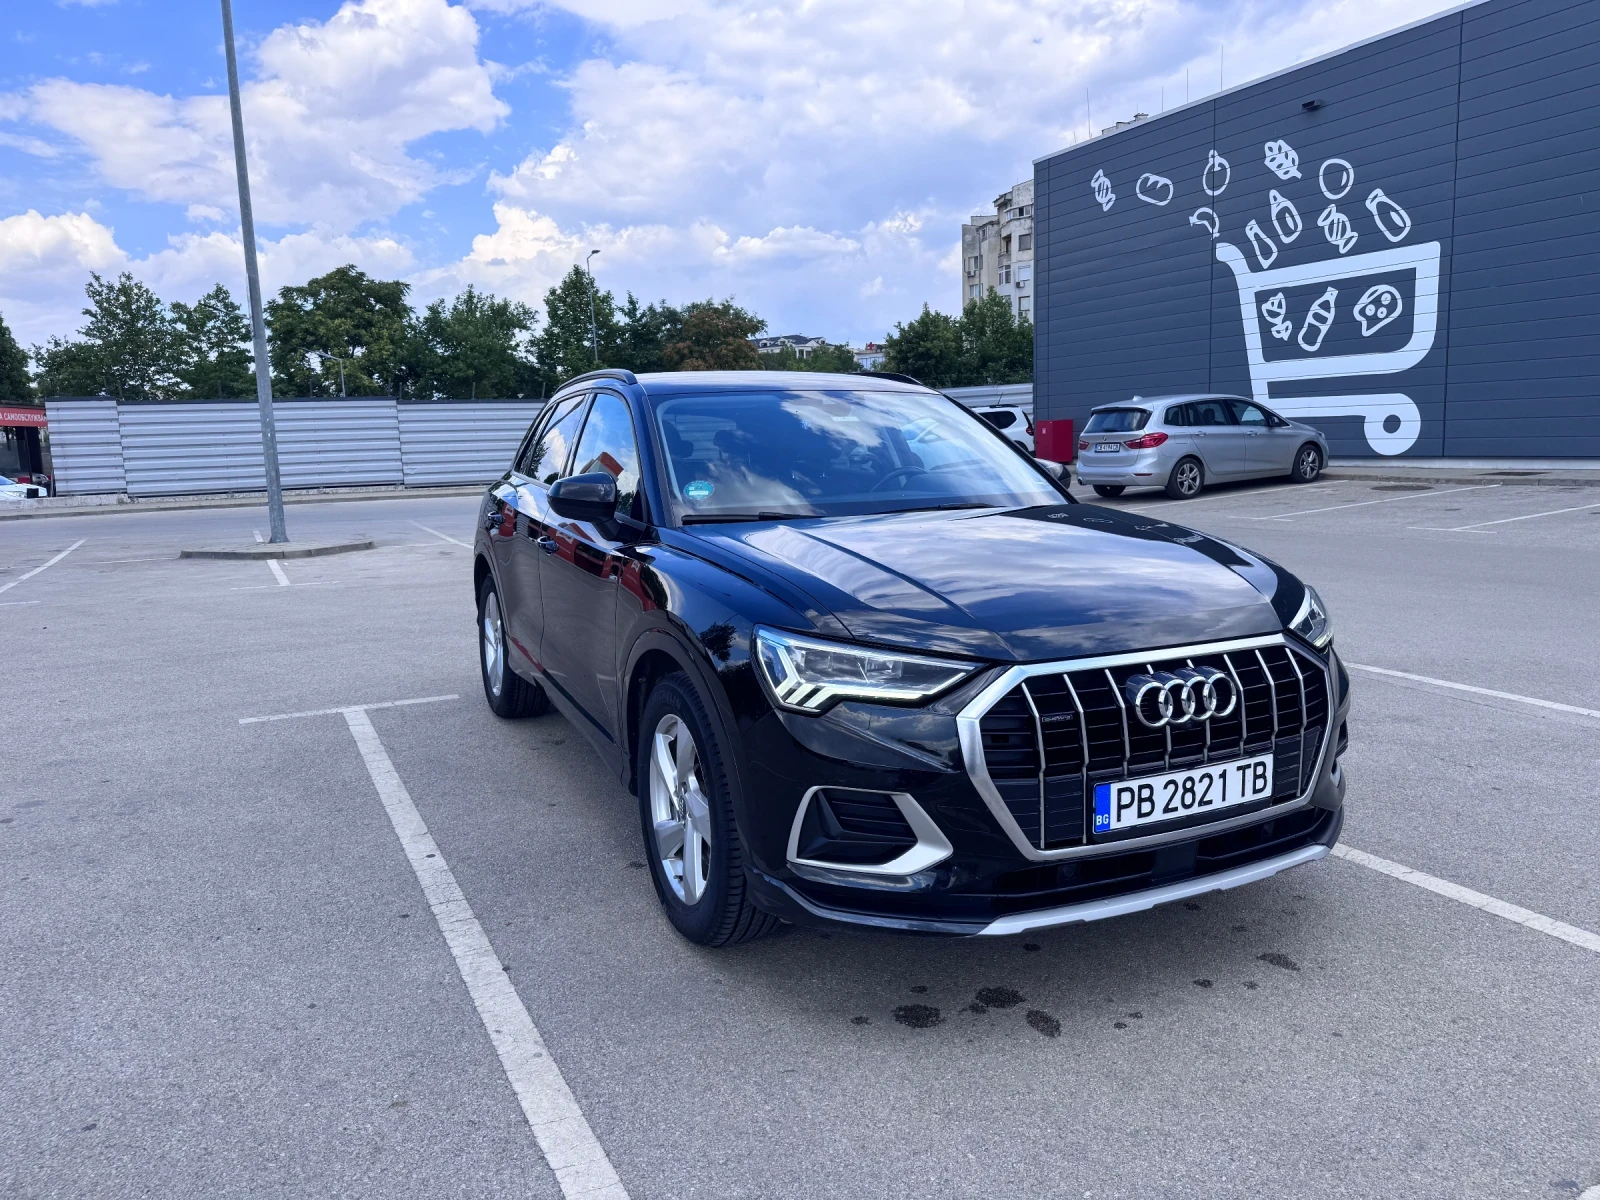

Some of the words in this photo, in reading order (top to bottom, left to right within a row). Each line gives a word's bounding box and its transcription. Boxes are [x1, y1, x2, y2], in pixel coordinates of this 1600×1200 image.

[1117, 783, 1155, 822] PB
[1163, 769, 1227, 814] 2821
[1236, 760, 1267, 797] TB
[1096, 814, 1109, 825] BG
